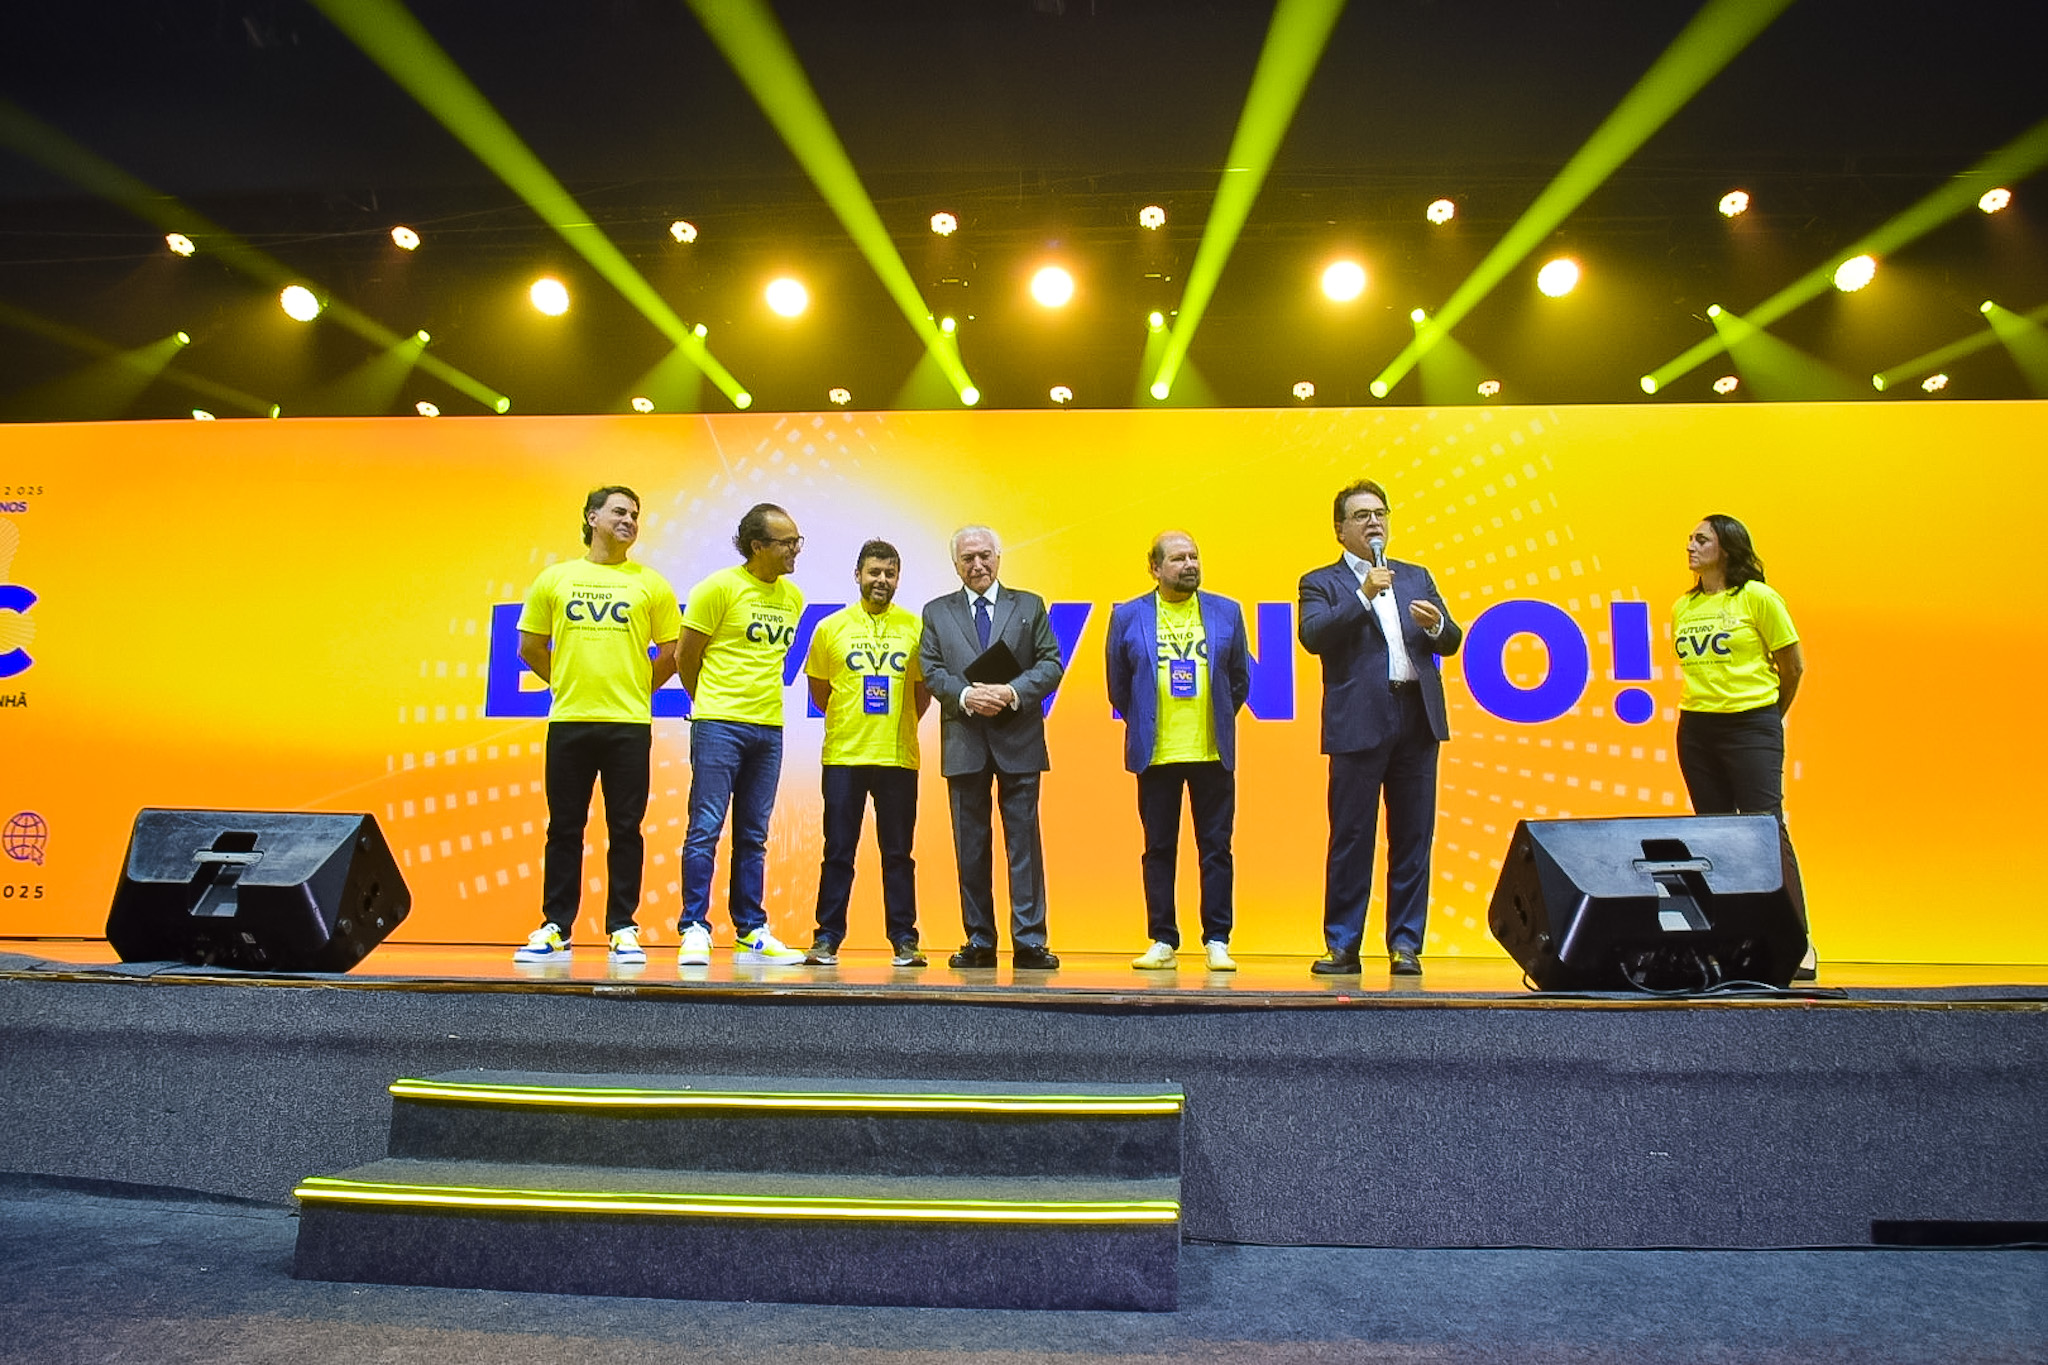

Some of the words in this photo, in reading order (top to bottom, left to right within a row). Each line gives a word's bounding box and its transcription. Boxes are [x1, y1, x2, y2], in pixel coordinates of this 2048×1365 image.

[572, 591, 613, 600] FUTURO
[566, 600, 631, 624] CVC
[752, 612, 784, 623] FUTURO
[746, 622, 795, 647] CVC
[1678, 624, 1715, 635] FUTURO
[1675, 632, 1731, 659] CVC
[846, 651, 907, 672] CVC
[1172, 672, 1193, 681] CVC
[866, 688, 887, 698] CVC
